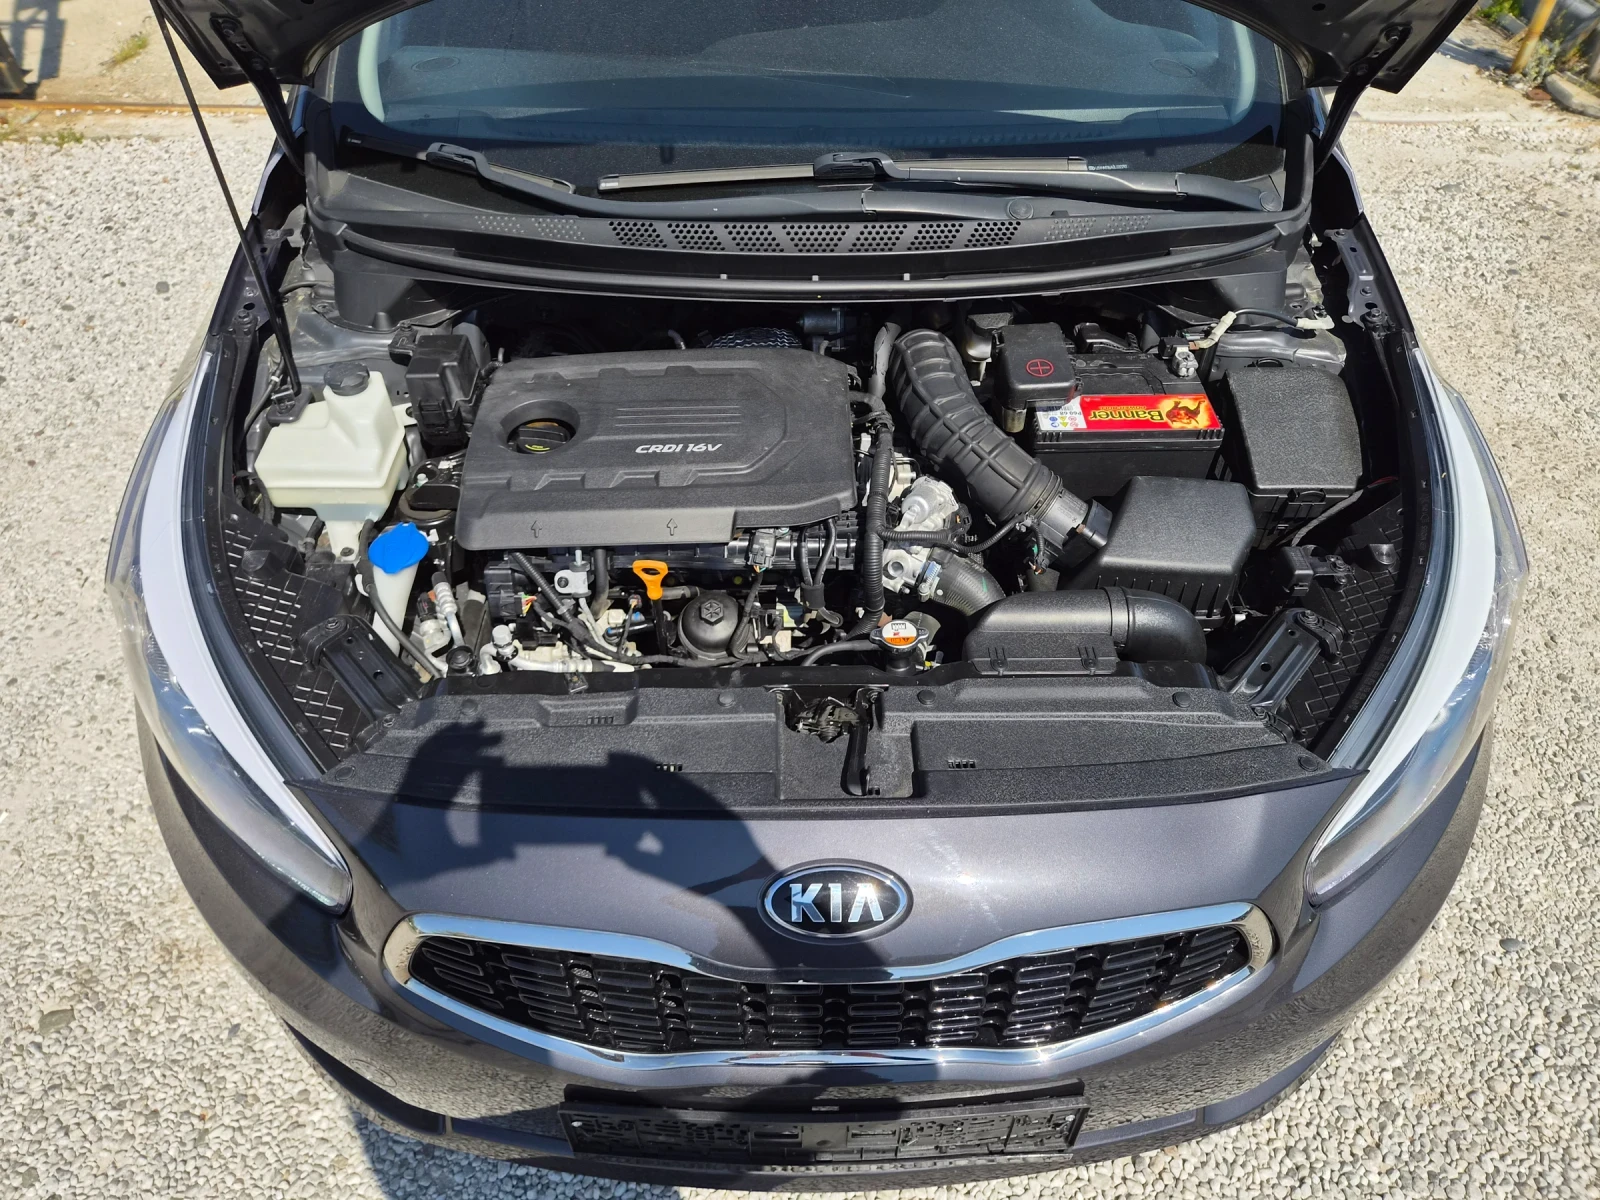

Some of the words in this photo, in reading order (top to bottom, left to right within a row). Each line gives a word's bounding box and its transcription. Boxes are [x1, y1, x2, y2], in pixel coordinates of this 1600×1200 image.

[1091, 410, 1165, 421] Banner
[635, 443, 684, 454] CRDI
[686, 443, 723, 452] 16V
[789, 882, 885, 923] KIA
